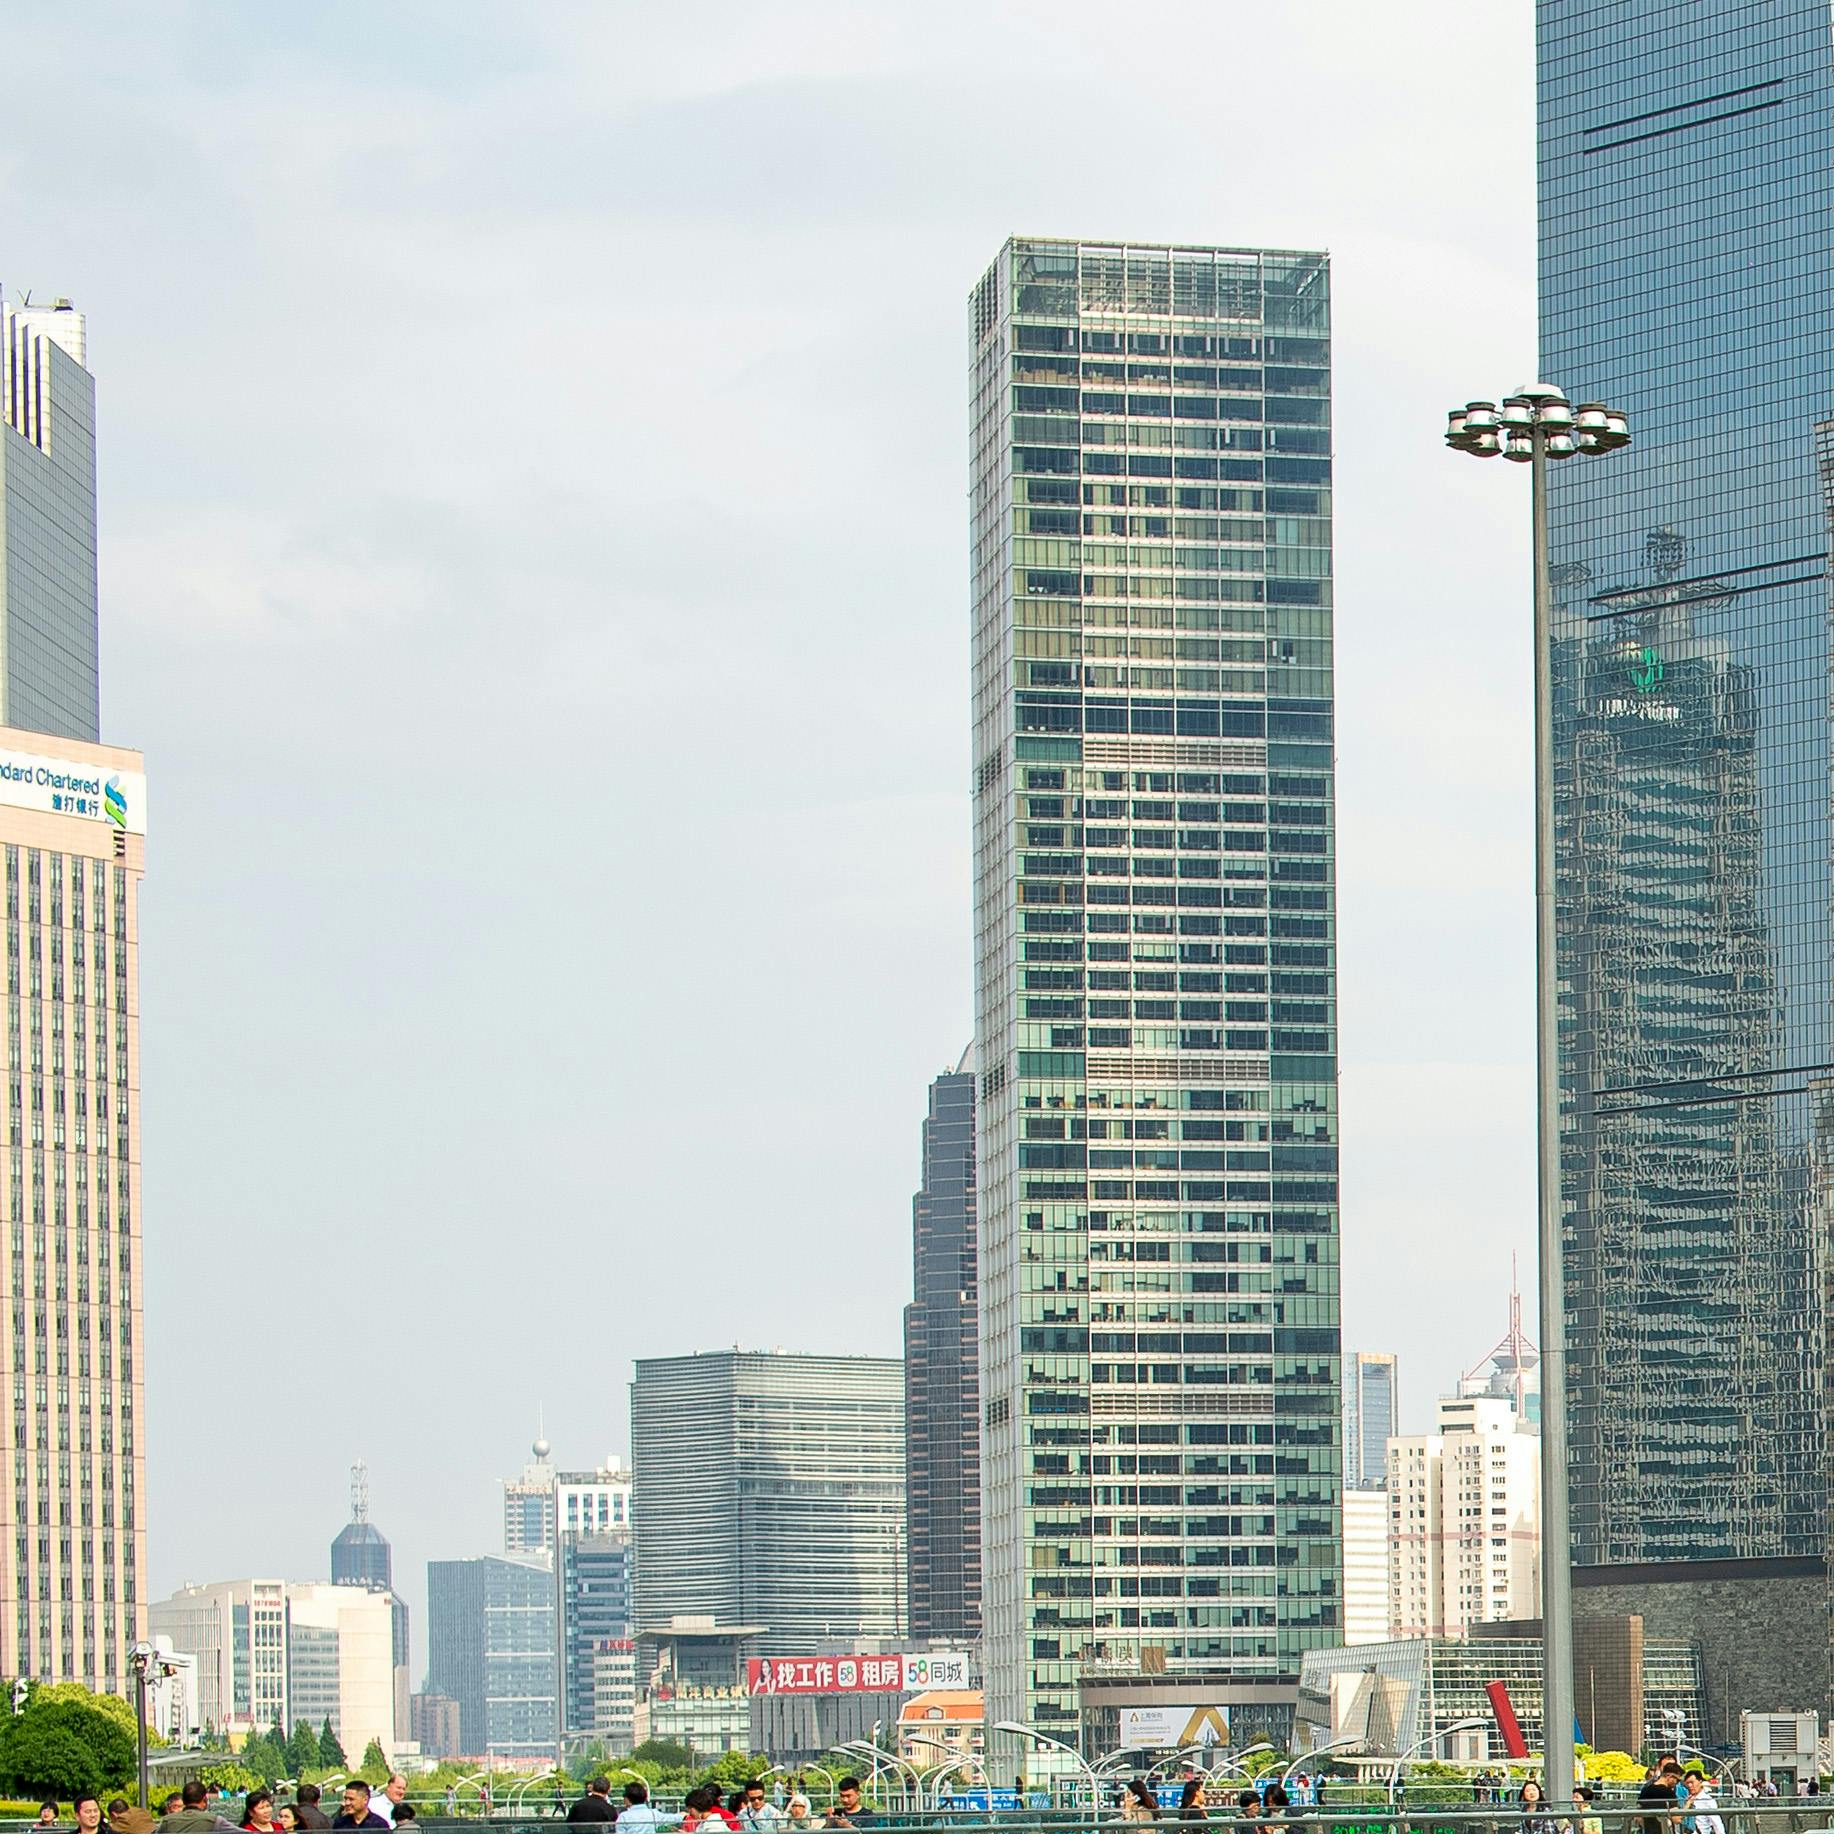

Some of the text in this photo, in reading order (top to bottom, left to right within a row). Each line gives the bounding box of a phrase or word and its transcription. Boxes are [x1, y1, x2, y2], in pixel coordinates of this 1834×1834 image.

[36, 767, 100, 795] Chartered
[777, 1660, 900, 1688] 找工作 58 租房
[908, 1659, 963, 1685] 58同城
